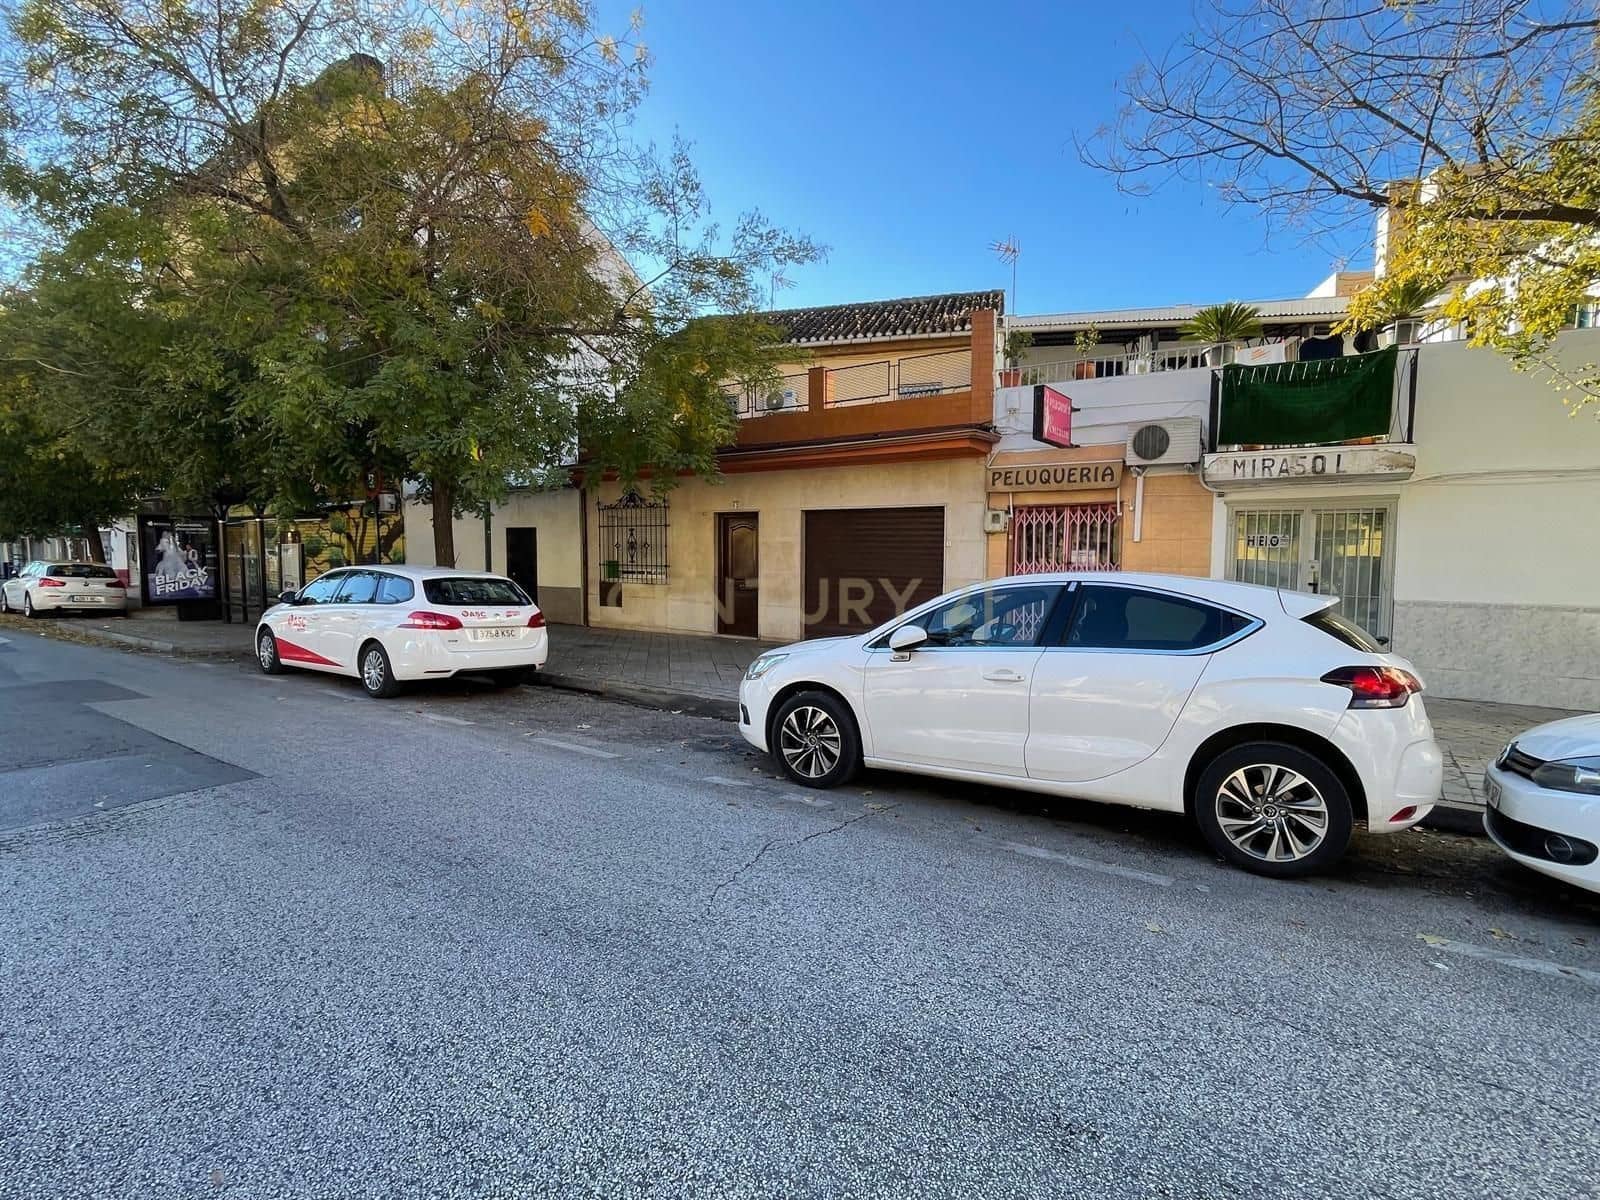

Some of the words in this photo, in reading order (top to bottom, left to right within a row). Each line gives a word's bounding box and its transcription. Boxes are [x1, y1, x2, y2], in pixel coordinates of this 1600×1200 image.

[1232, 453, 1347, 478] MIRASOL
[991, 465, 1115, 487] PELUQUERIA
[155, 566, 209, 585] BLACK
[156, 576, 209, 595] FRIDAY
